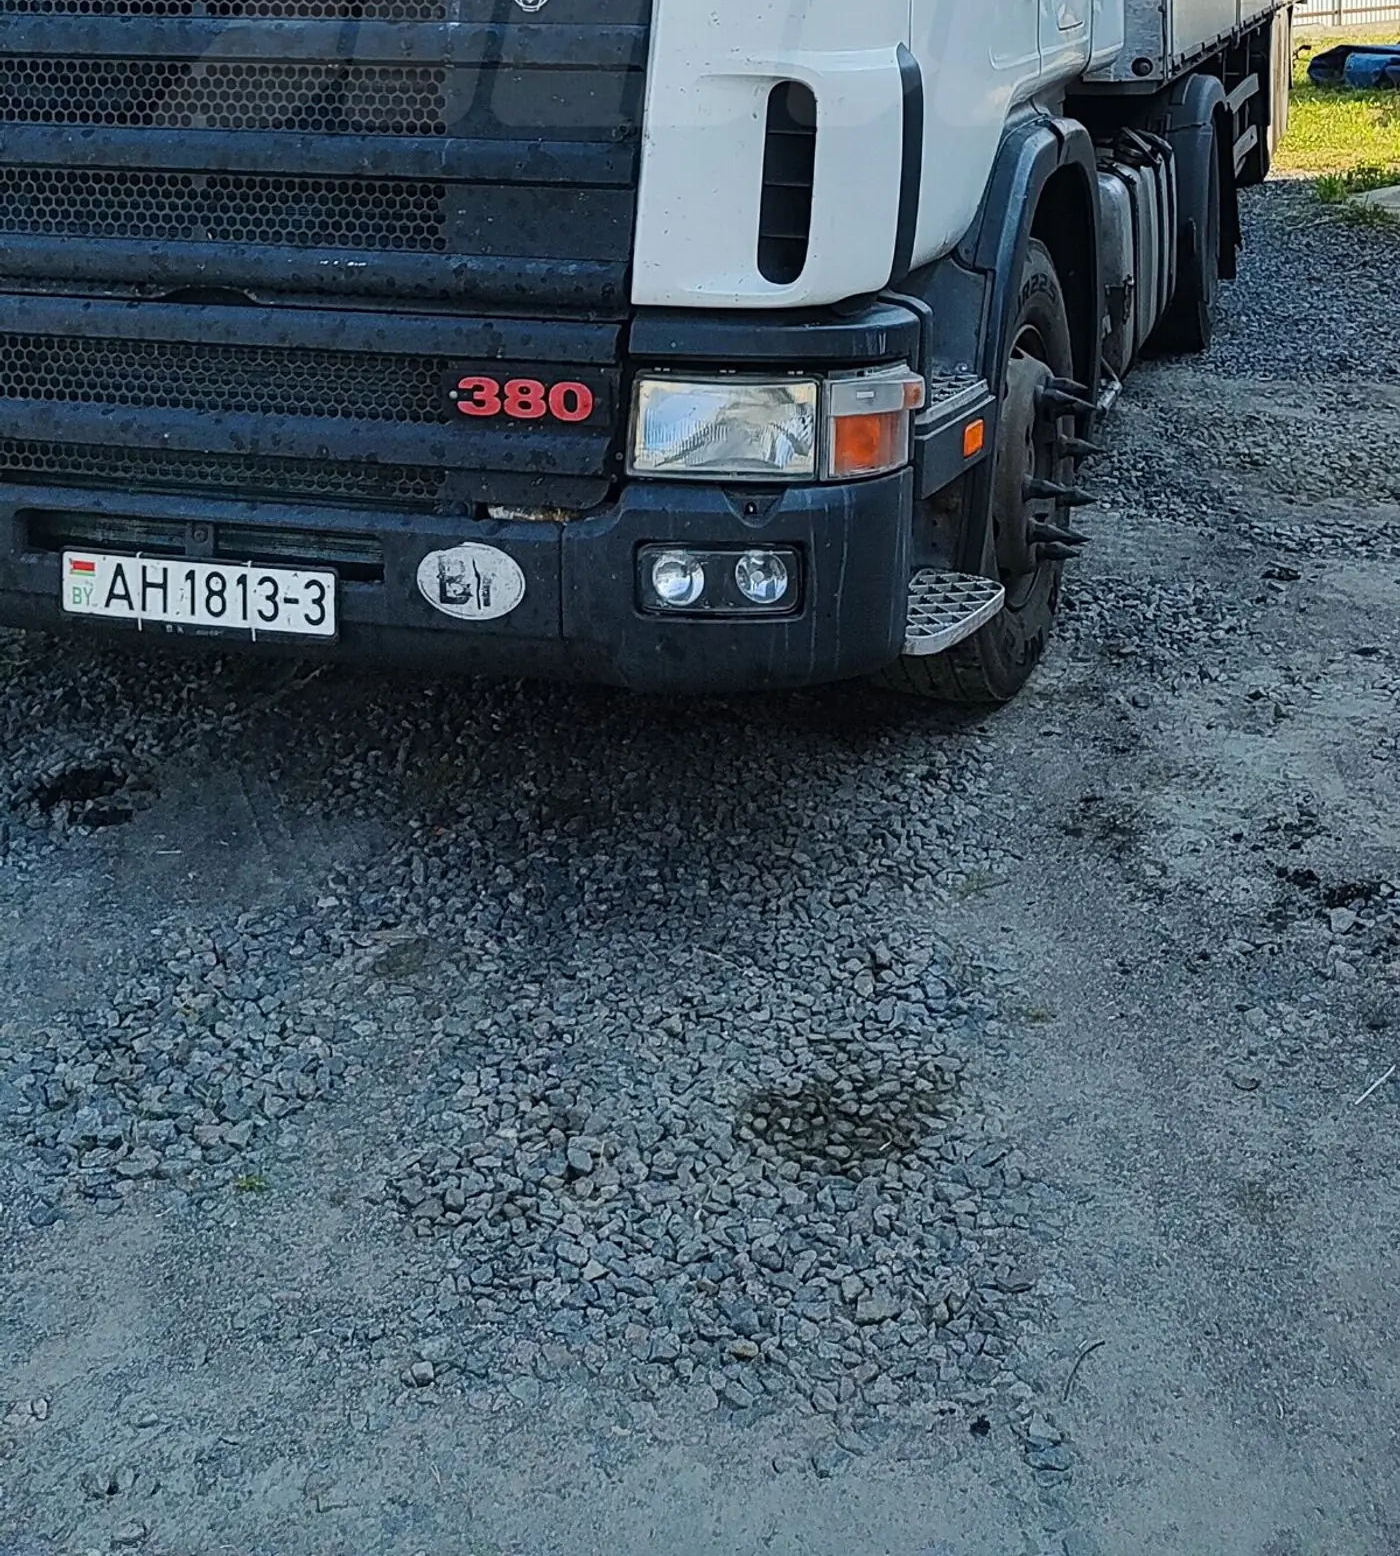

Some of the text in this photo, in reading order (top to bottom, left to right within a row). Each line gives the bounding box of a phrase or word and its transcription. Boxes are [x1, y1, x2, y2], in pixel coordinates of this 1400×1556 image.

[457, 375, 593, 422] 380
[71, 585, 95, 607] BY
[104, 562, 326, 627] AH 1813-3
